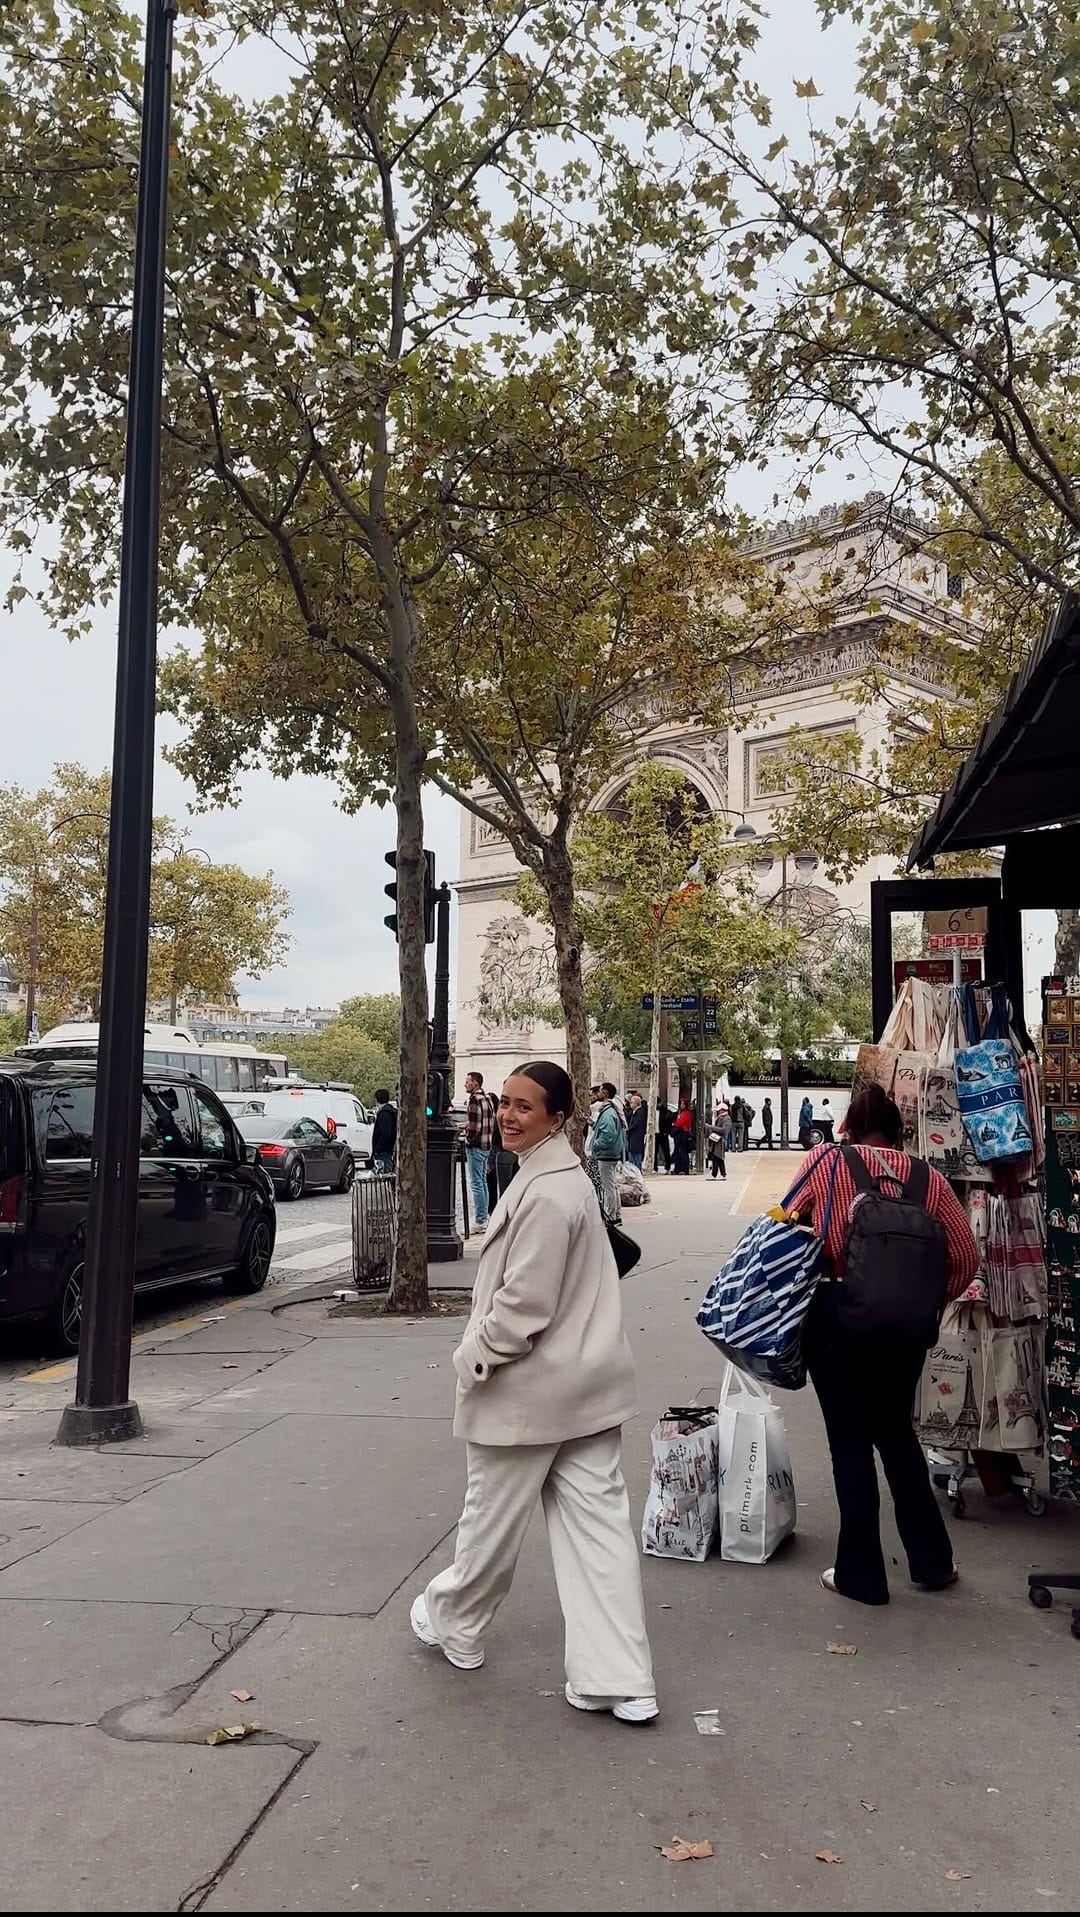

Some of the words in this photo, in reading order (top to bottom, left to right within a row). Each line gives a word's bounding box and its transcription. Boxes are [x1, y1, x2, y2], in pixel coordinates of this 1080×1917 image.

[948, 911, 960, 932] 6
[965, 908, 975, 920] €
[981, 1087, 1018, 1105] PAR
[929, 1347, 965, 1362] Paris
[739, 1441, 758, 1532] primark.com
